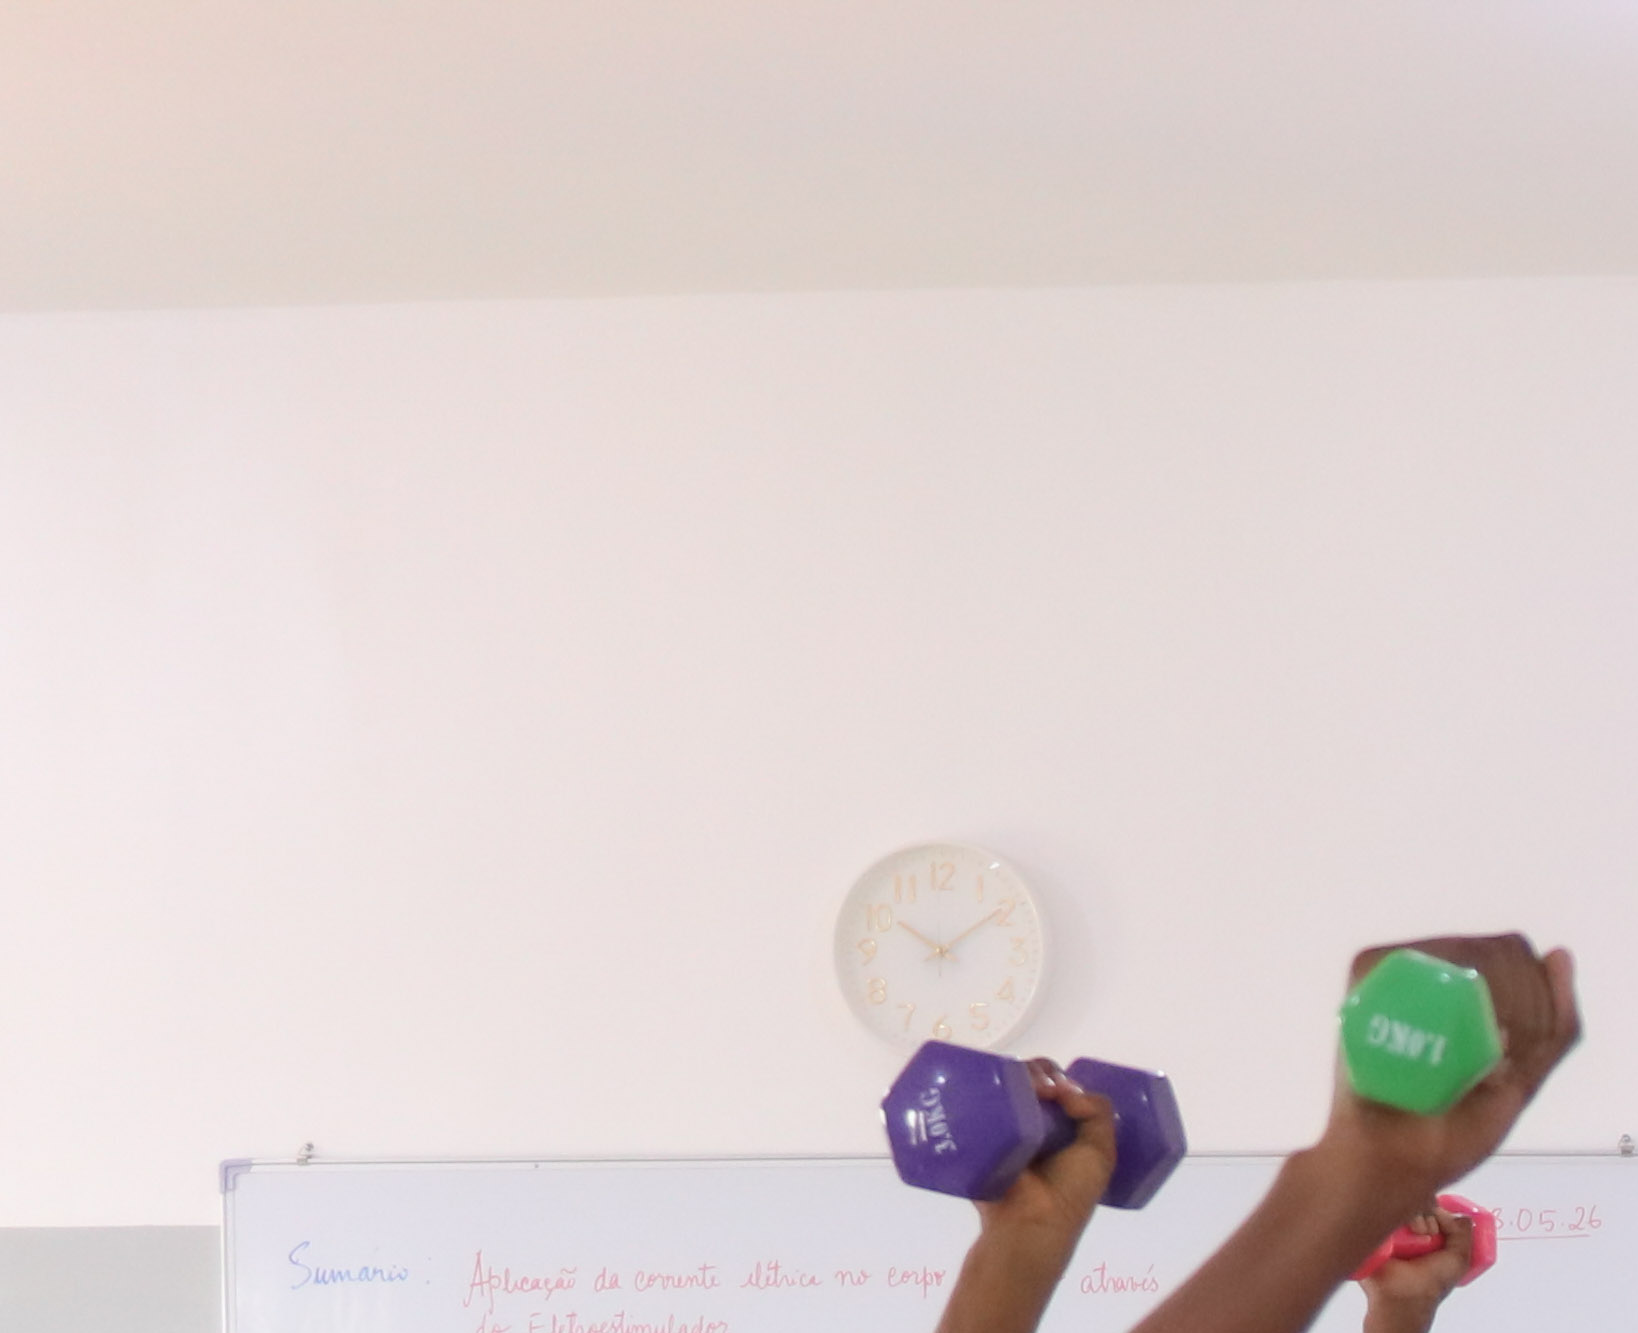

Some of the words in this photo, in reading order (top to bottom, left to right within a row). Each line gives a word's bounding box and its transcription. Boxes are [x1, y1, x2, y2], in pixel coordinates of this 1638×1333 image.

[893, 873, 917, 903] 11
[929, 861, 956, 891] 12
[976, 874, 985, 904] 1
[866, 903, 893, 933] 10
[994, 896, 1017, 927] 2
[856, 937, 877, 966] 9
[1008, 936, 1027, 967] 3
[867, 977, 887, 1005] 8
[996, 975, 1015, 1002] 4
[897, 1002, 917, 1033] 7
[932, 1014, 953, 1040] 6
[969, 1002, 990, 1031] 5
[1367, 1013, 1447, 1066] 1.0KG
[920, 1087, 958, 1153] 3.0KG
[463, 1249, 578, 1315] Aplicação
[594, 1266, 622, 1293] da
[634, 1263, 721, 1293] corrente
[834, 1269, 872, 1287] no
[887, 1266, 947, 1299] corpo
[1080, 1260, 1159, 1294] através
